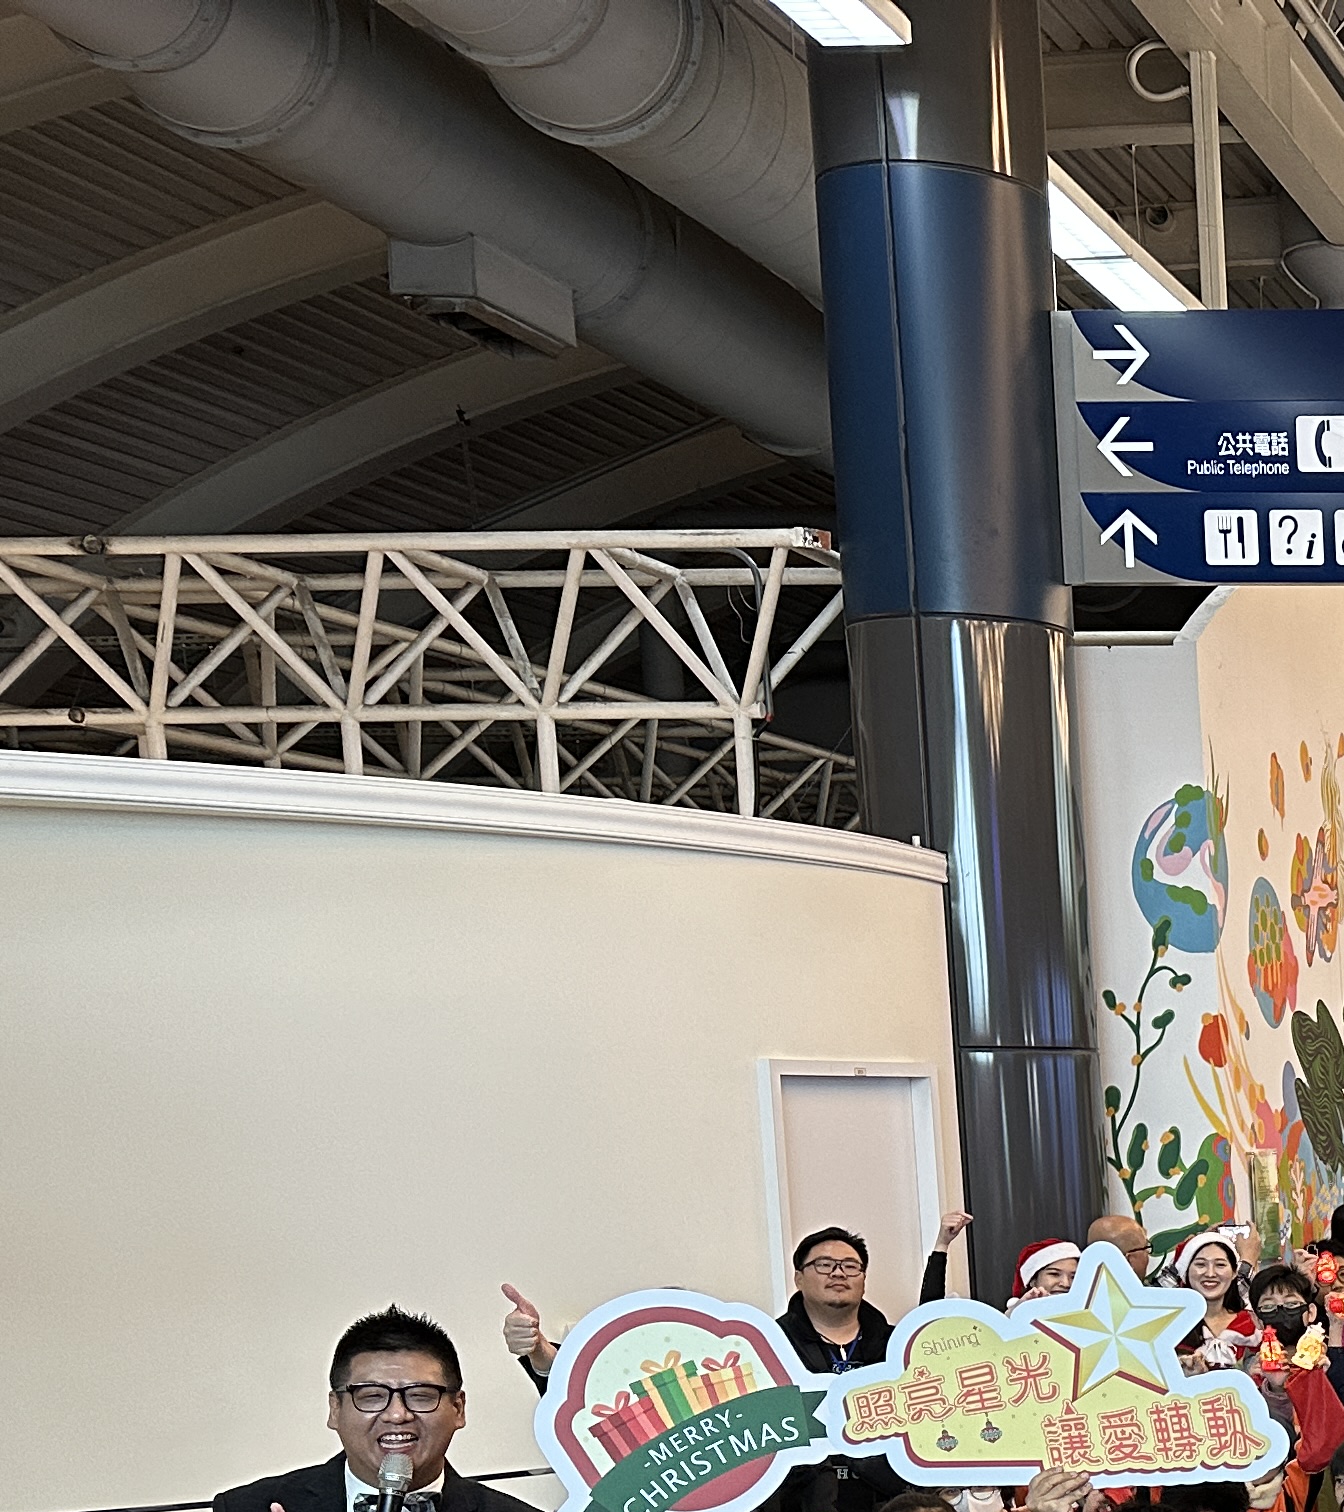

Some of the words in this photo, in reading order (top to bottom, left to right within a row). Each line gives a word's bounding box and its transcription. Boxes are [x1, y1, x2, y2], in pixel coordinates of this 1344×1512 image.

[1217, 431, 1289, 456] 公共電話
[1187, 460, 1225, 475] Public
[1226, 460, 1290, 478] Telephone
[921, 1332, 981, 1356] Shining
[852, 1351, 1060, 1433] 照亮星光
[1043, 1394, 1264, 1470] 讓愛轉動
